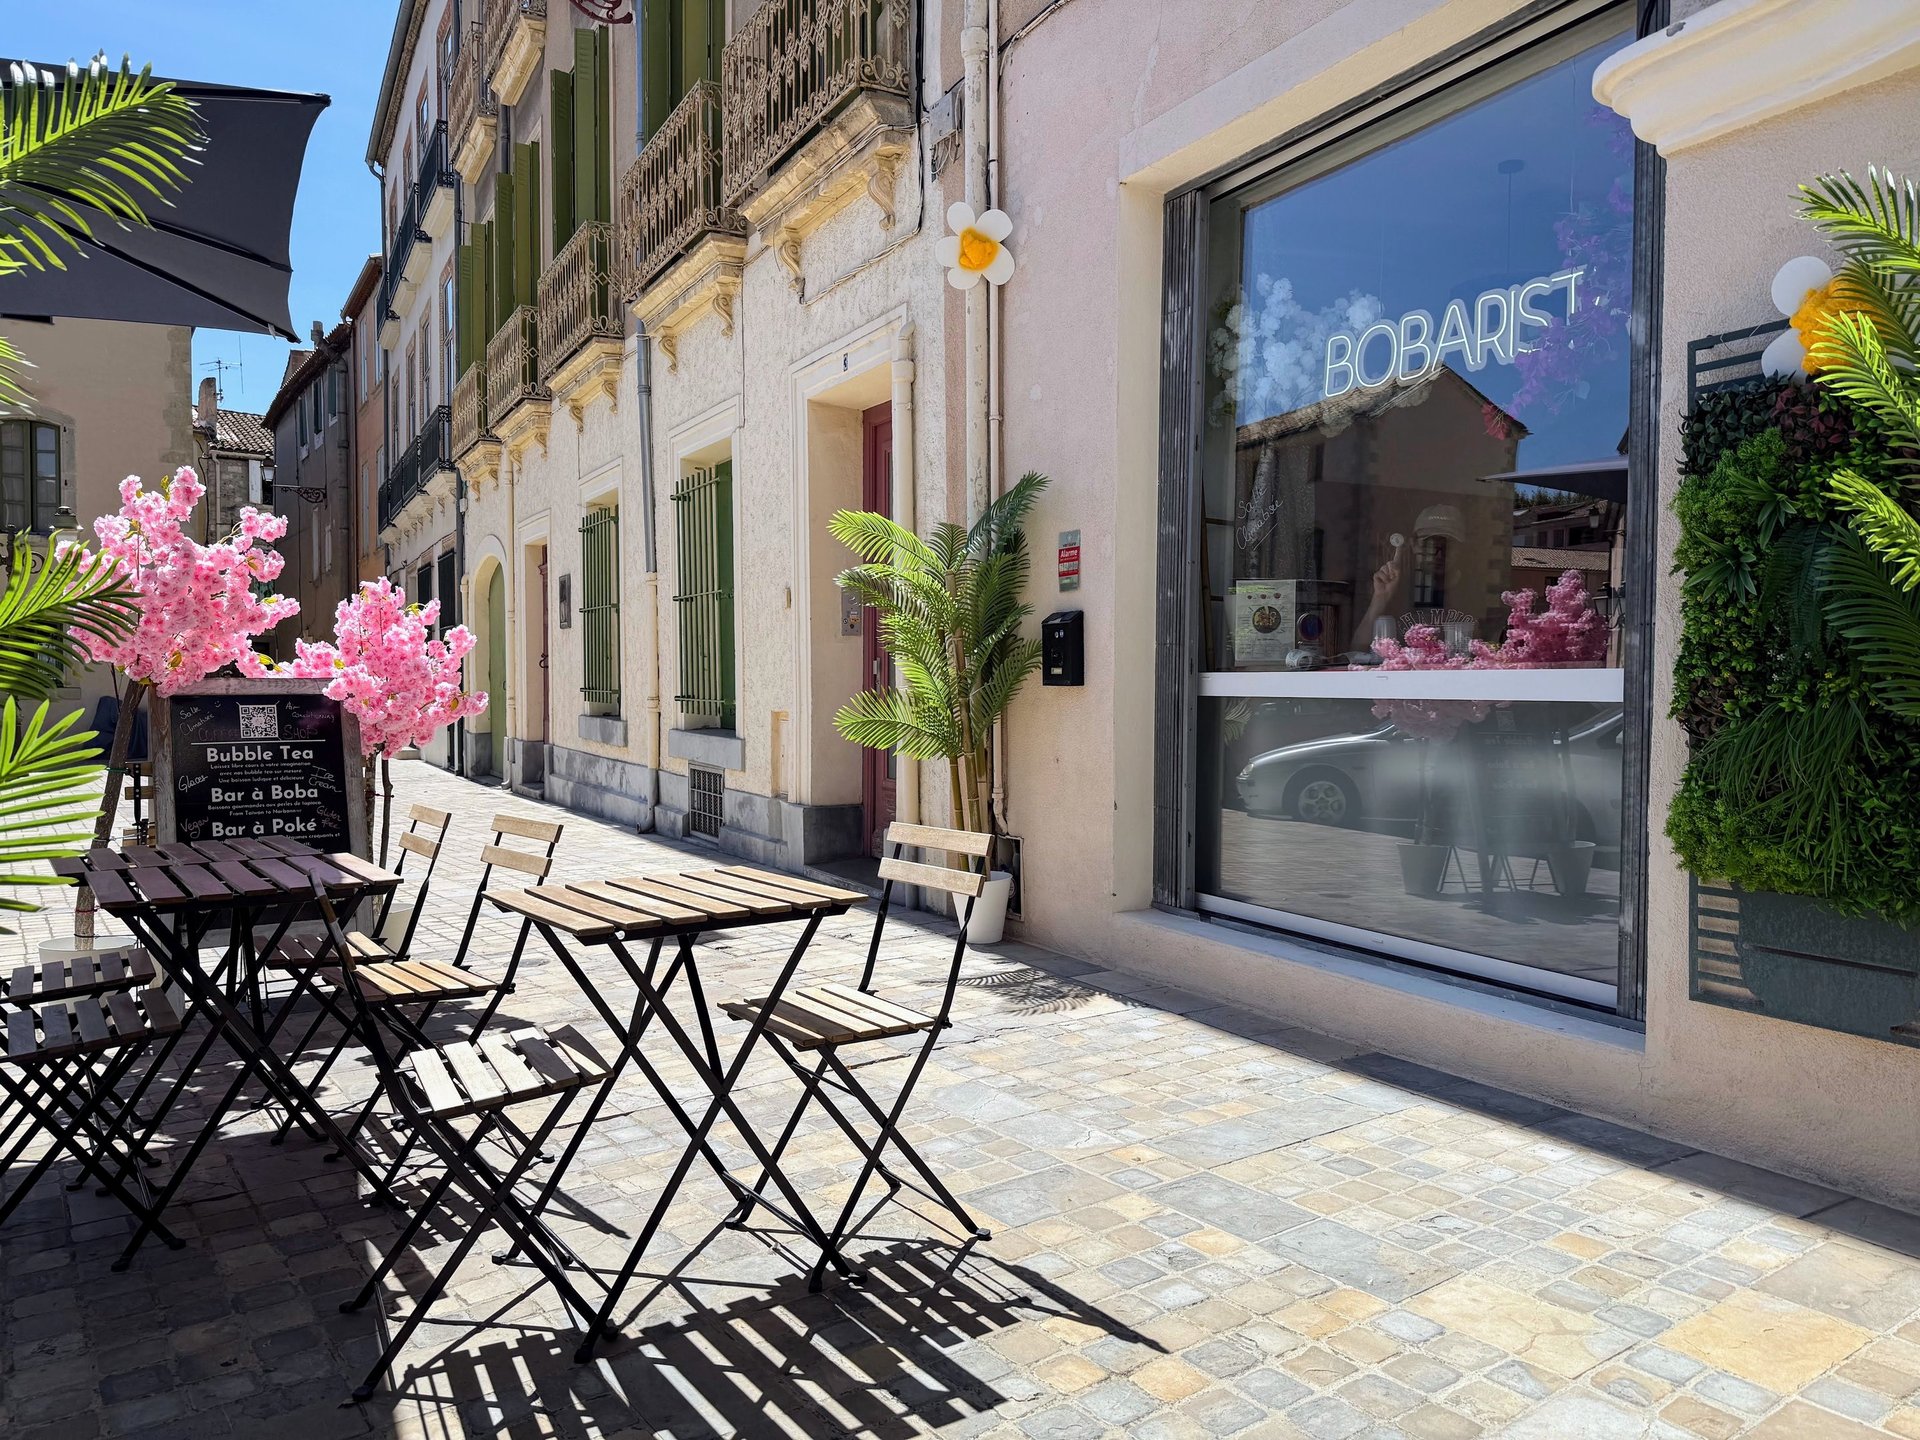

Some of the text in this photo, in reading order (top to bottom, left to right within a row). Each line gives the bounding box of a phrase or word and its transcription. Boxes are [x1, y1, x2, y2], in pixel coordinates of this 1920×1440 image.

[1322, 264, 1600, 398] BOBARIST
[1238, 486, 1267, 519] Salle
[1060, 549, 1078, 558] Alarme
[179, 705, 202, 720] Salle
[207, 745, 313, 762] Bubble Tea
[310, 765, 336, 782] Ice
[211, 783, 318, 803] Bar à Boba
[308, 776, 342, 793] Cream
[180, 816, 209, 839] Vegan
[212, 816, 317, 837] Bar à Poké
